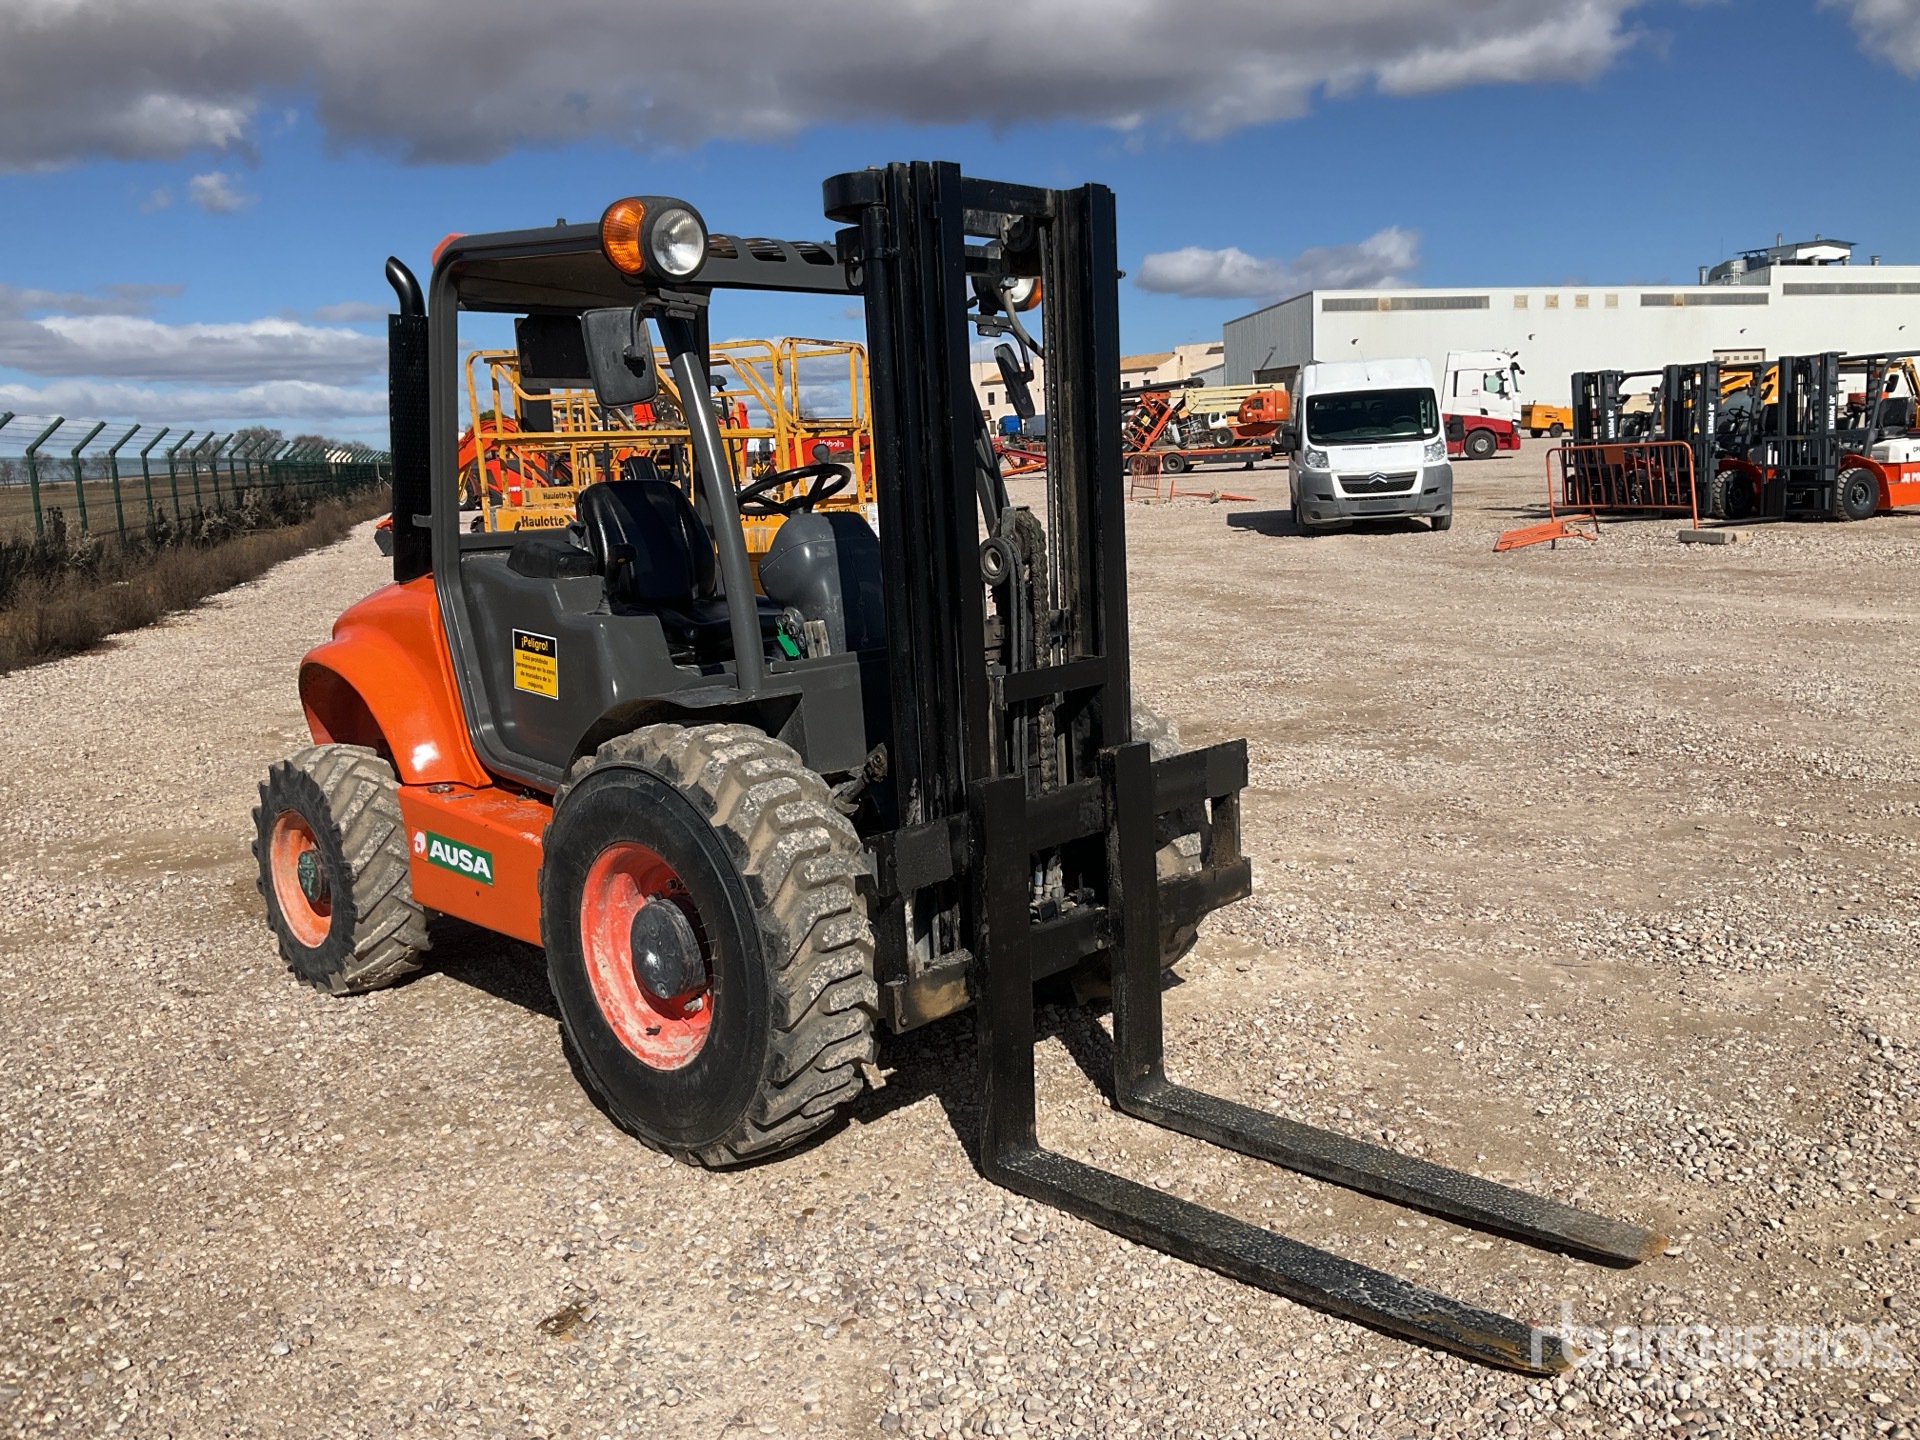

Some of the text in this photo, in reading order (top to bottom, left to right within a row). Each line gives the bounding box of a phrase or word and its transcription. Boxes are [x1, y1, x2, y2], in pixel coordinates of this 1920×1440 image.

[543, 491, 567, 500] Haulotte
[520, 515, 565, 528] Haulotte
[429, 839, 492, 879] AUSA
